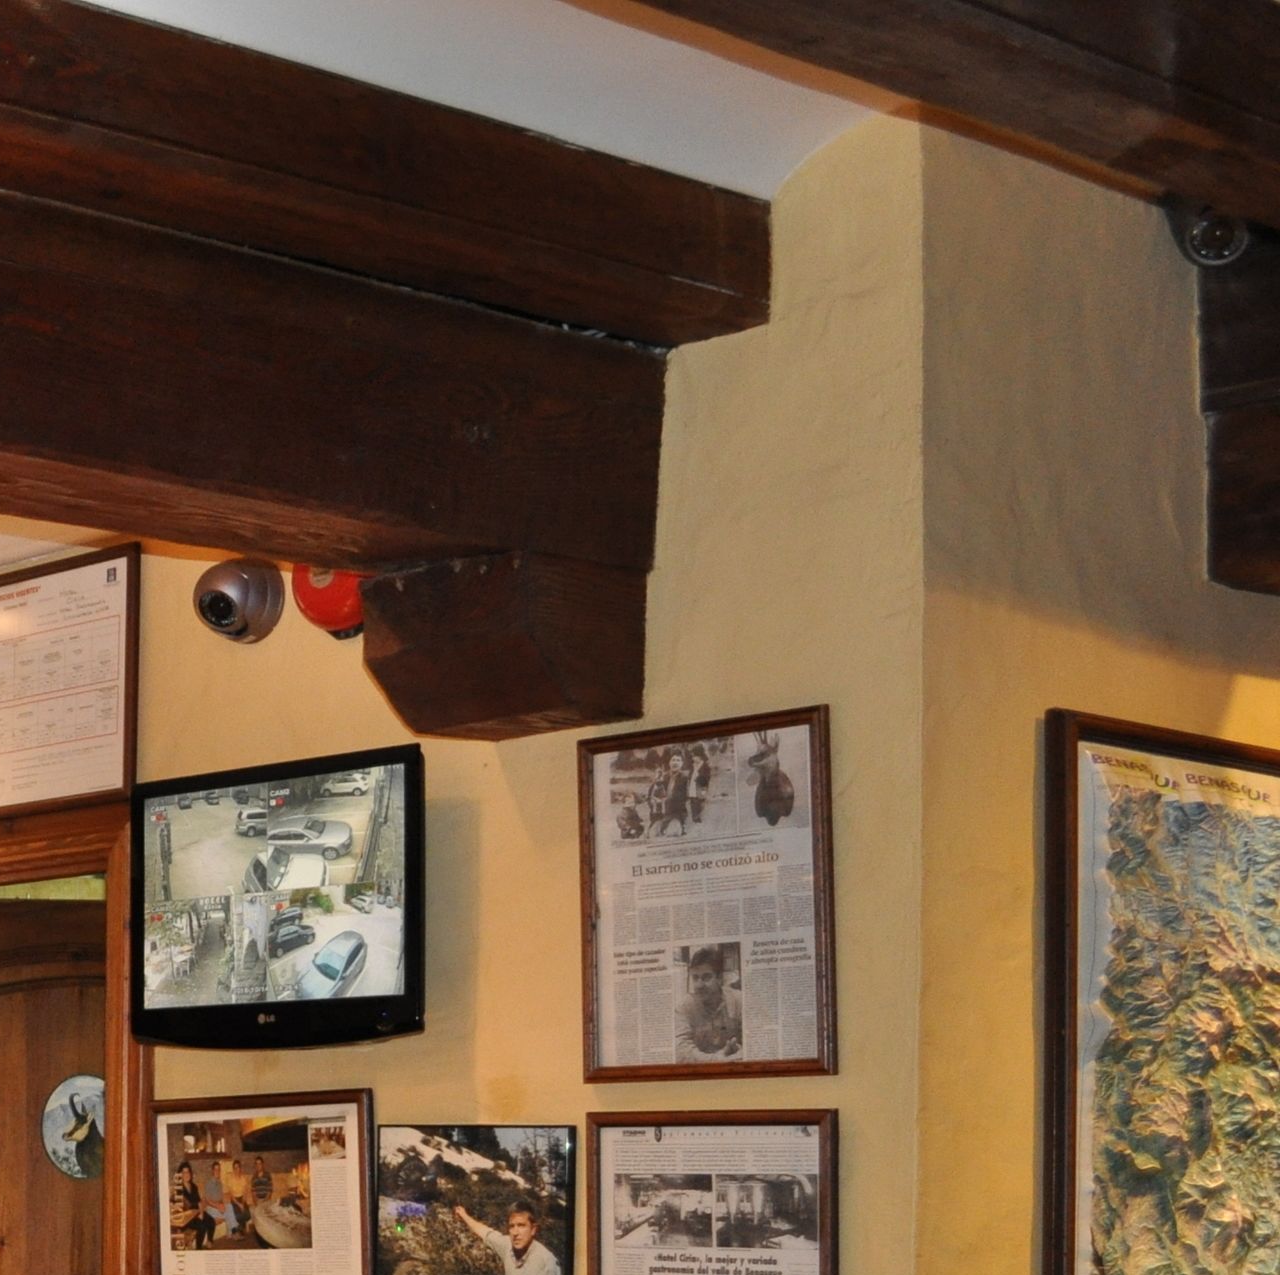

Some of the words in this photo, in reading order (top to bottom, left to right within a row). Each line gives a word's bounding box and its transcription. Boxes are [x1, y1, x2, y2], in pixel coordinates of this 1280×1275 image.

[632, 865, 643, 877] El
[645, 861, 680, 875] sarrio
[683, 861, 698, 872] no
[700, 858, 713, 870] se
[715, 853, 752, 868] cotizó
[754, 851, 779, 864] alto
[715, 1255, 738, 1266] mejor
[747, 1256, 778, 1266] variada
[697, 1265, 709, 1275] del
[711, 1266, 730, 1275] valle
[733, 1267, 742, 1275] de
